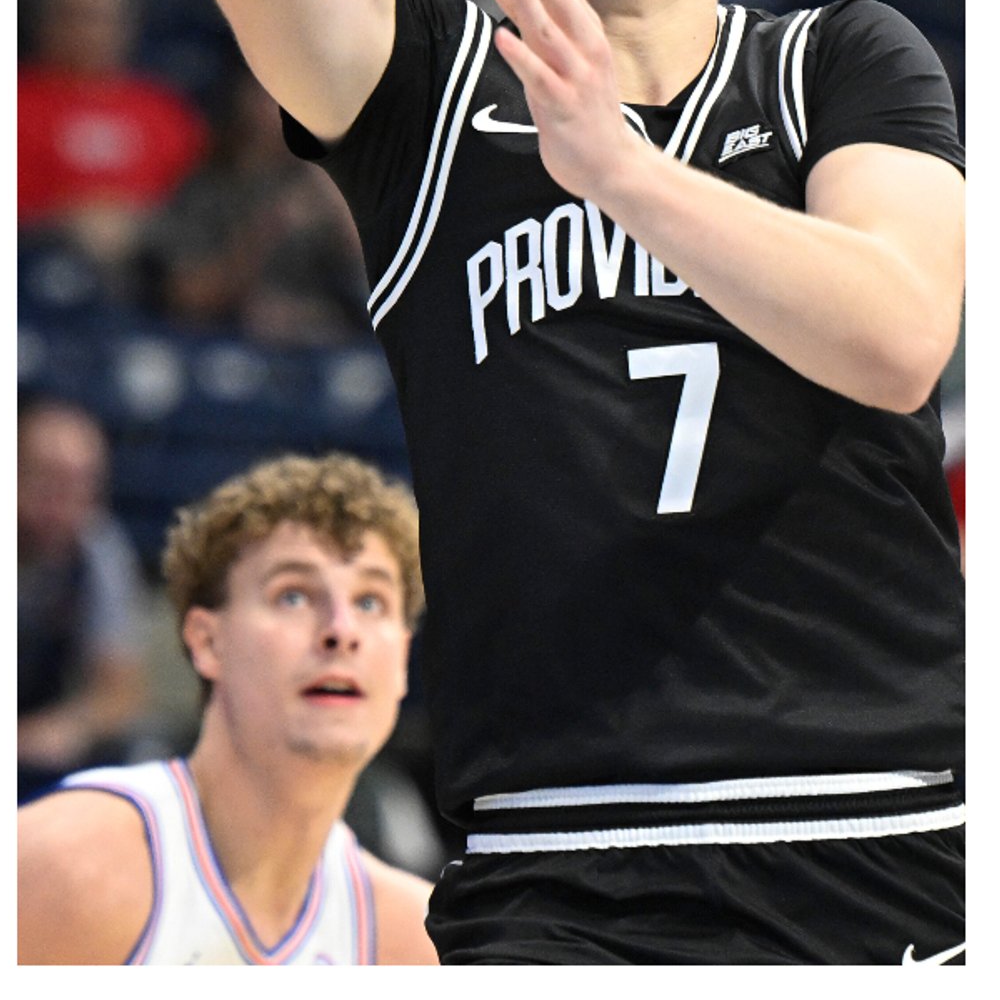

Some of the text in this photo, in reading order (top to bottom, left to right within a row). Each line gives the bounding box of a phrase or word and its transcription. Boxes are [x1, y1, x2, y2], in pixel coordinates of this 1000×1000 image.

[720, 131, 772, 158] EAST
[726, 123, 760, 142] BIG
[627, 342, 720, 514] 7
